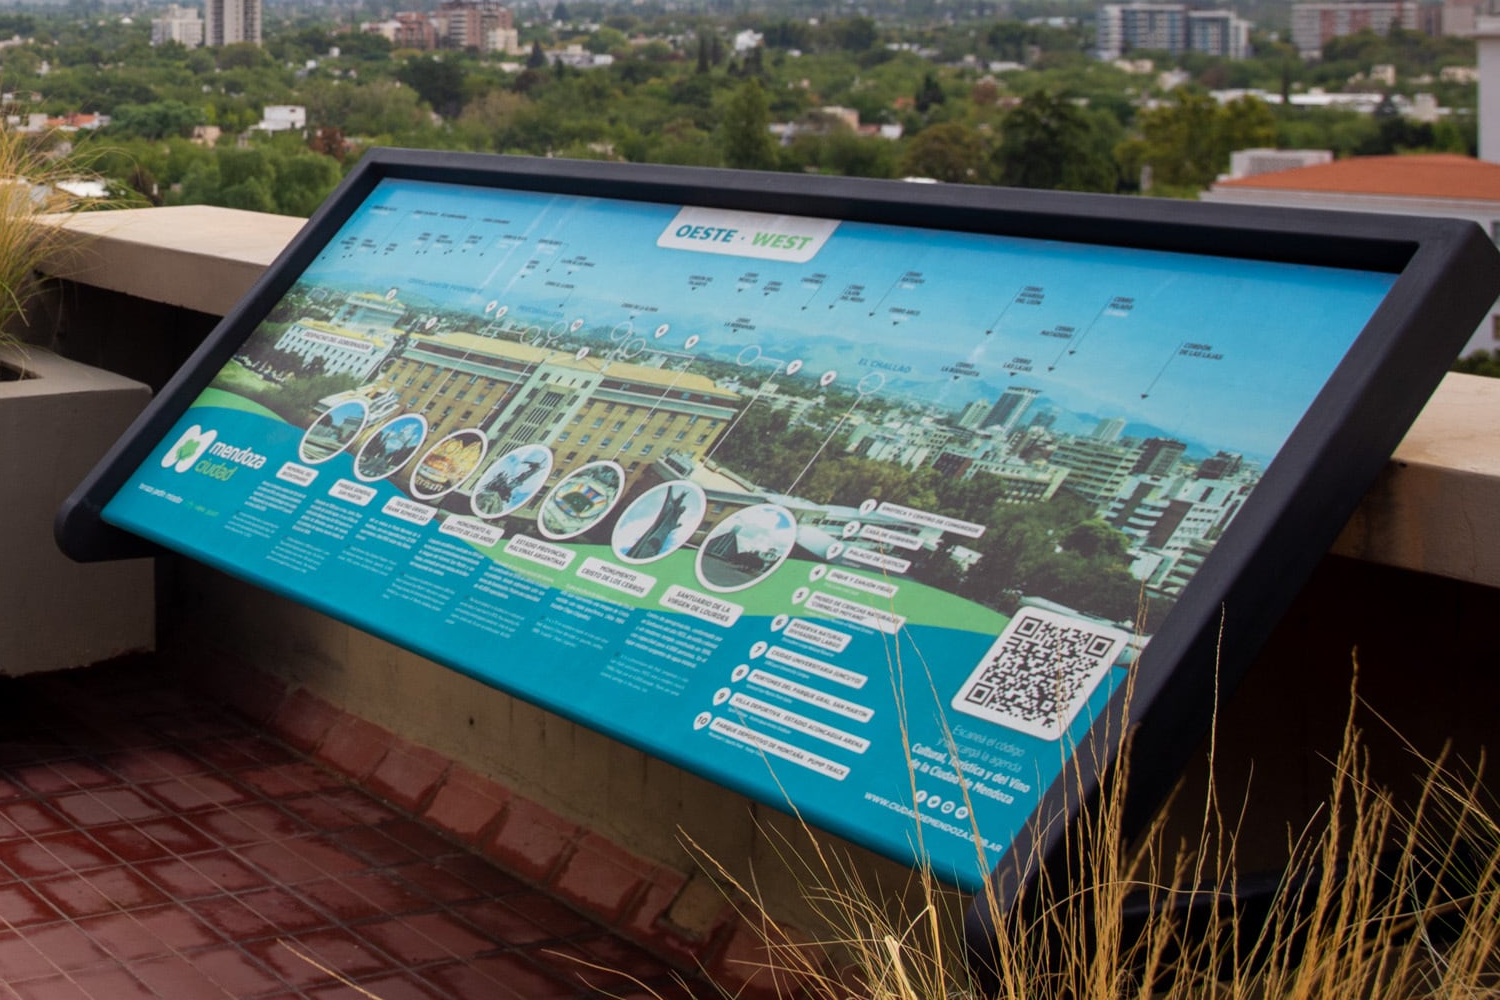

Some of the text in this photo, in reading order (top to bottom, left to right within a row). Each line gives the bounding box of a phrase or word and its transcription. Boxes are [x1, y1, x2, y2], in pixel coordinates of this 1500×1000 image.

[676, 224, 814, 250] OESTE WEST
[209, 441, 267, 469] mendoza
[195, 458, 238, 481] ciudad
[581, 568, 602, 579] CRISTO
[609, 577, 622, 585] LOS
[621, 581, 645, 593] CERROS
[600, 566, 637, 582] MONUMENTO
[667, 597, 690, 608] VIRGEN
[699, 608, 729, 622] LOURDES
[676, 591, 712, 607] SANTUARIO
[735, 697, 750, 706] VILLA
[697, 716, 708, 725] 10
[807, 758, 825, 767] PUMP
[826, 764, 845, 776] TRACK
[911, 743, 946, 764] Cultural,
[983, 771, 993, 780] y
[992, 773, 1010, 785] del
[1009, 777, 1031, 793] Vino
[919, 762, 930, 773] la
[972, 782, 1014, 804] Mendoza
